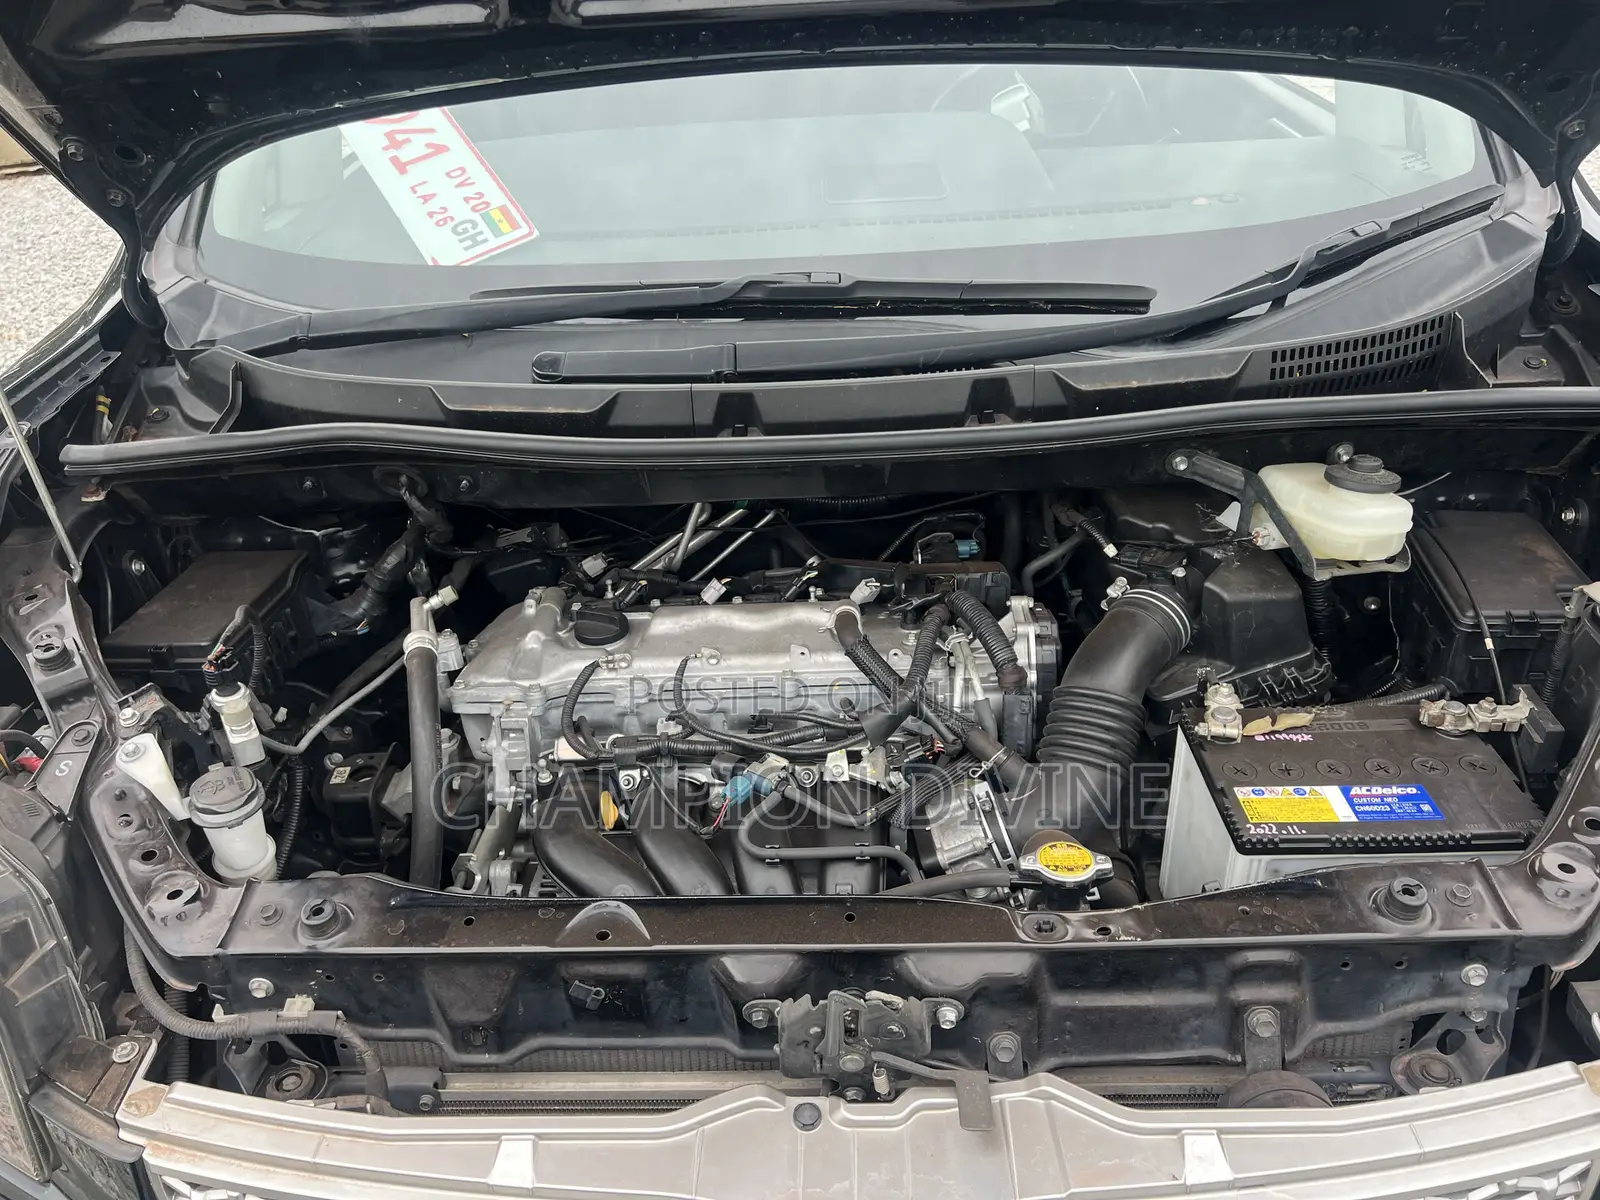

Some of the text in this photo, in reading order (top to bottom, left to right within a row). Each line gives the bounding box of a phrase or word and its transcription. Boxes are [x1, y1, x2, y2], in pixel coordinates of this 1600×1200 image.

[410, 180, 455, 228] LA 26
[445, 166, 491, 214] DV 20
[450, 218, 489, 252] GH
[55, 760, 73, 776] S
[1350, 786, 1418, 795] ACDelco
